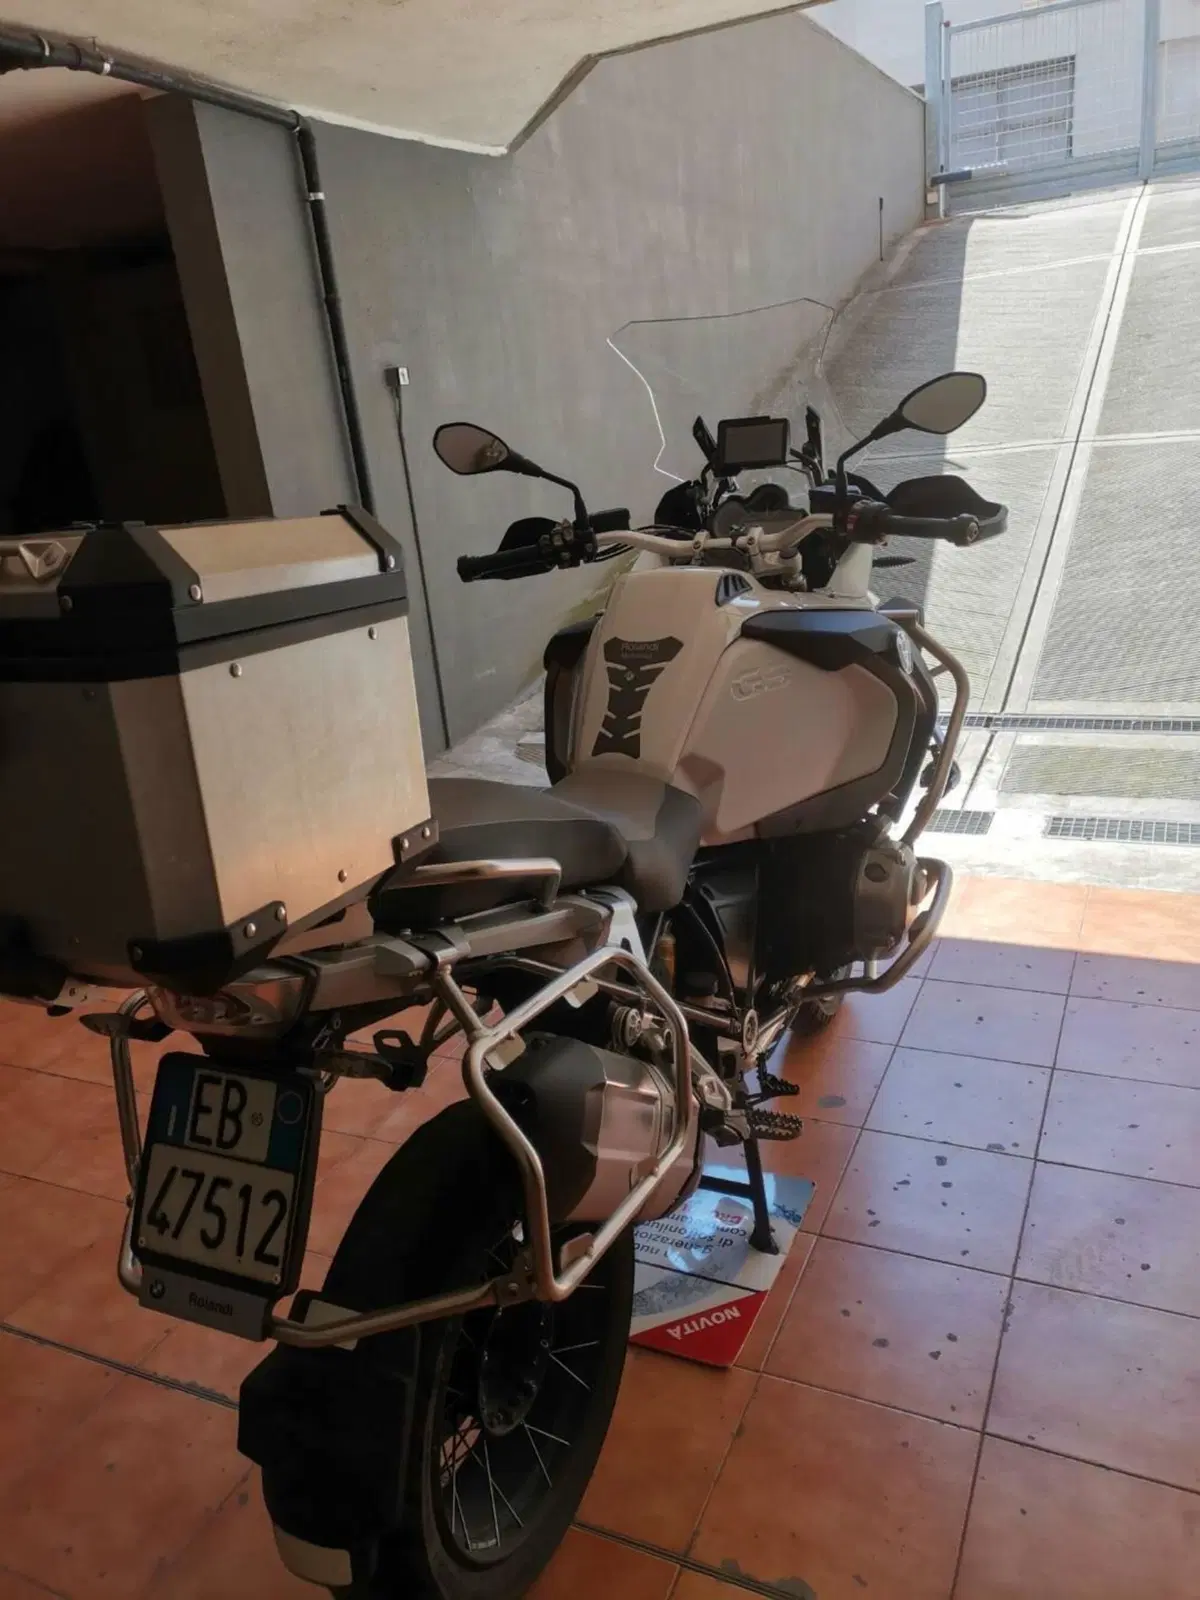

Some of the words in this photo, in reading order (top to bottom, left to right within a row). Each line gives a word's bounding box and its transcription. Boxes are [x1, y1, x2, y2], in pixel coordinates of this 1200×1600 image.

[188, 1074, 248, 1150] EB
[146, 1165, 289, 1266] 47512
[718, 1237, 735, 1249] di
[666, 1305, 741, 1340] NOVITÀ
